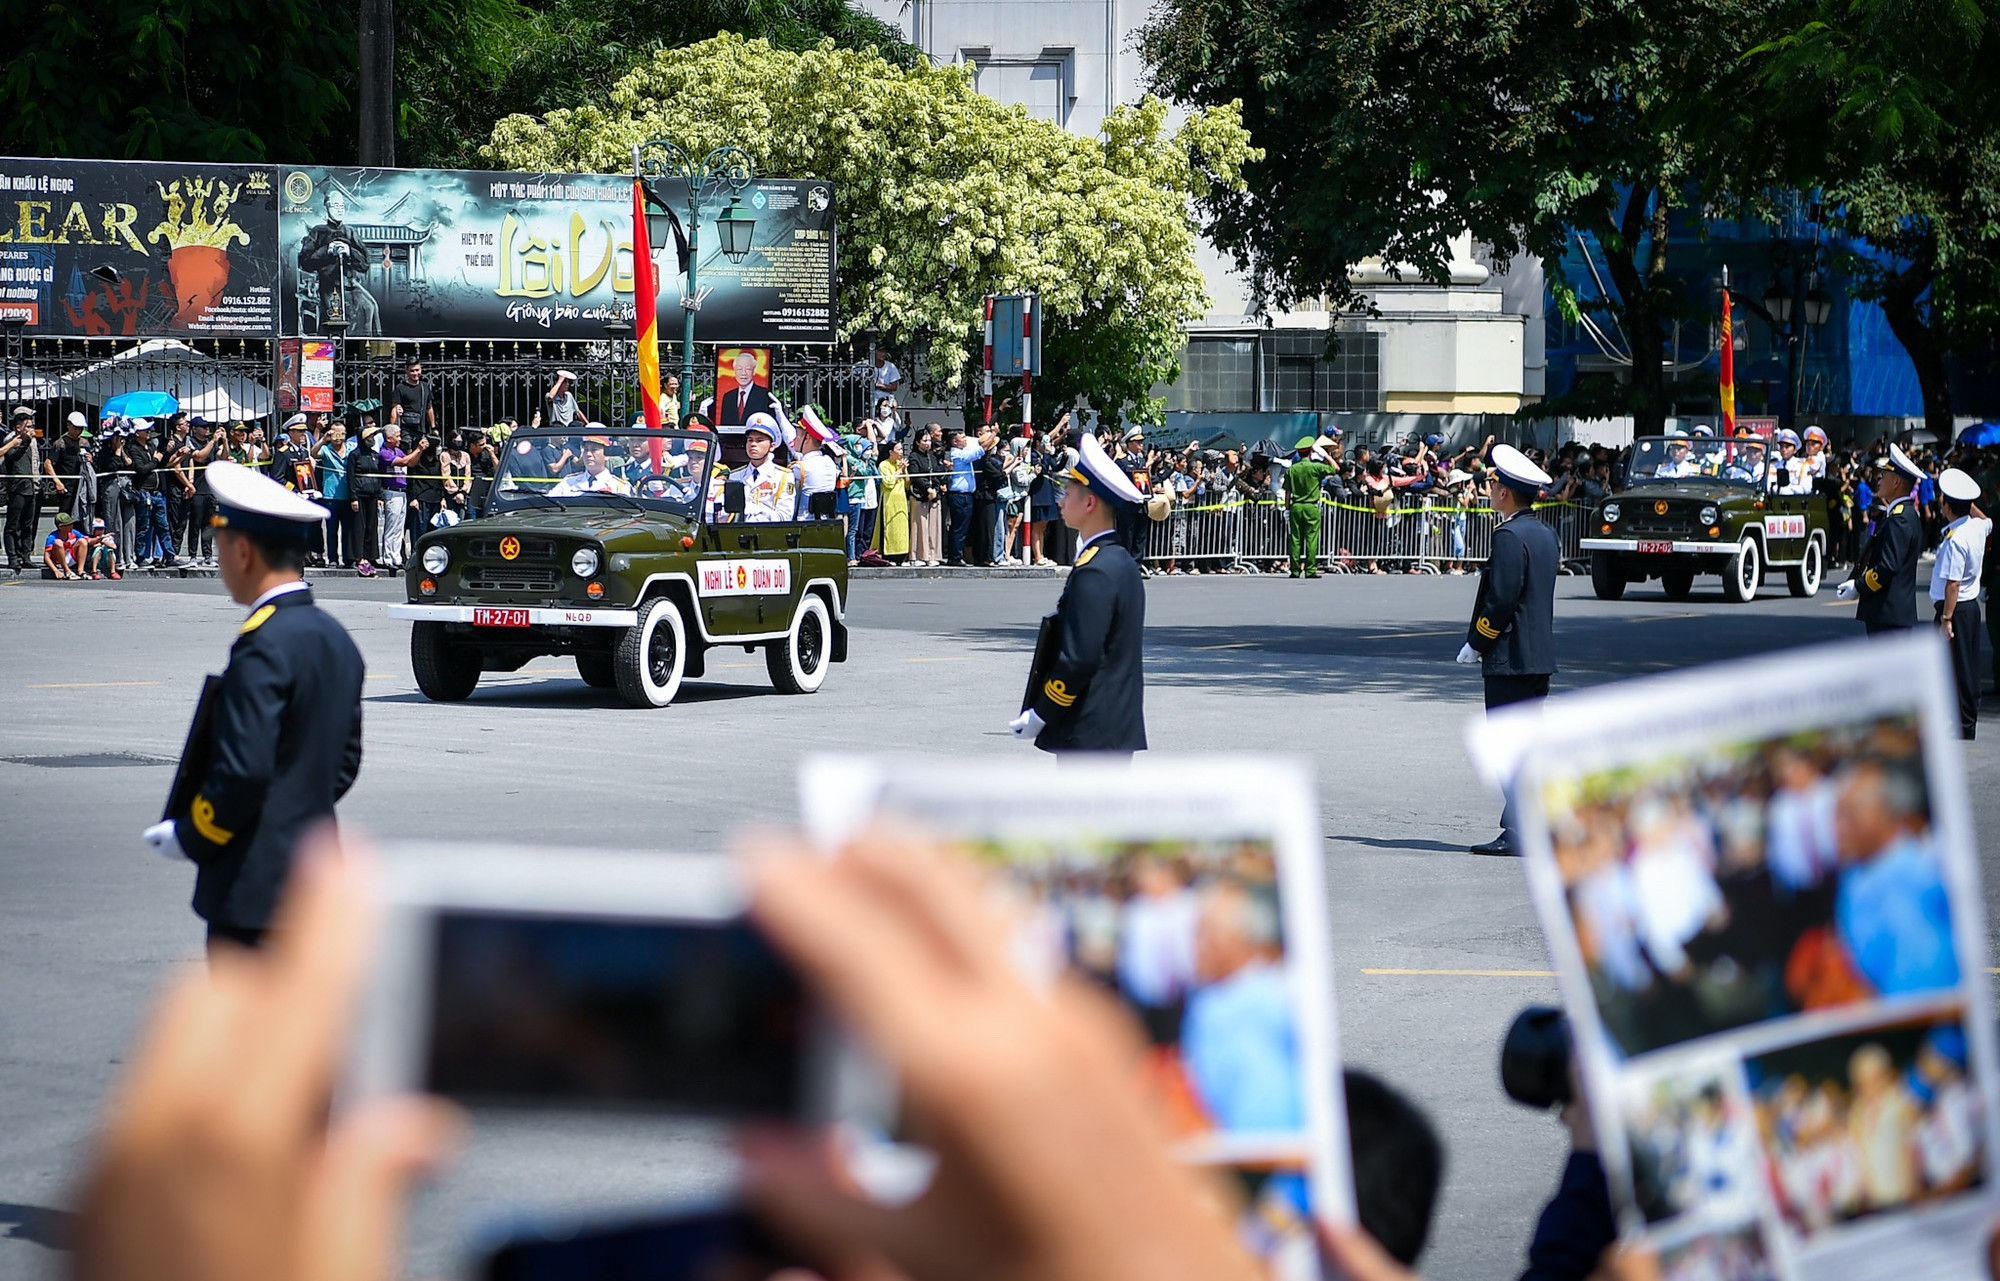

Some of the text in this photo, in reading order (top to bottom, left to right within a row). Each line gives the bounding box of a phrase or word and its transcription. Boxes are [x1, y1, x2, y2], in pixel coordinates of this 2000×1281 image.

[12, 175, 36, 190] KHẤU
[38, 175, 48, 193] LỆ
[50, 178, 74, 194] NGỌC
[490, 181, 508, 199] MỘT
[509, 182, 525, 198] TÁC
[479, 231, 493, 246] TÁC
[494, 211, 563, 298] Lôi
[16, 267, 41, 285] ĐƯỢC
[43, 266, 53, 282] GÌ
[6, 287, 38, 300] nothing
[222, 296, 271, 305] 0916.152.882
[554, 300, 579, 320] bão
[782, 308, 830, 317] 0916152882
[1344, 431, 1378, 444] THE
[704, 570, 722, 590] NGHI
[753, 565, 771, 591] QUÂN
[774, 565, 785, 592] ĐỘI
[475, 609, 527, 625] TM-27-01
